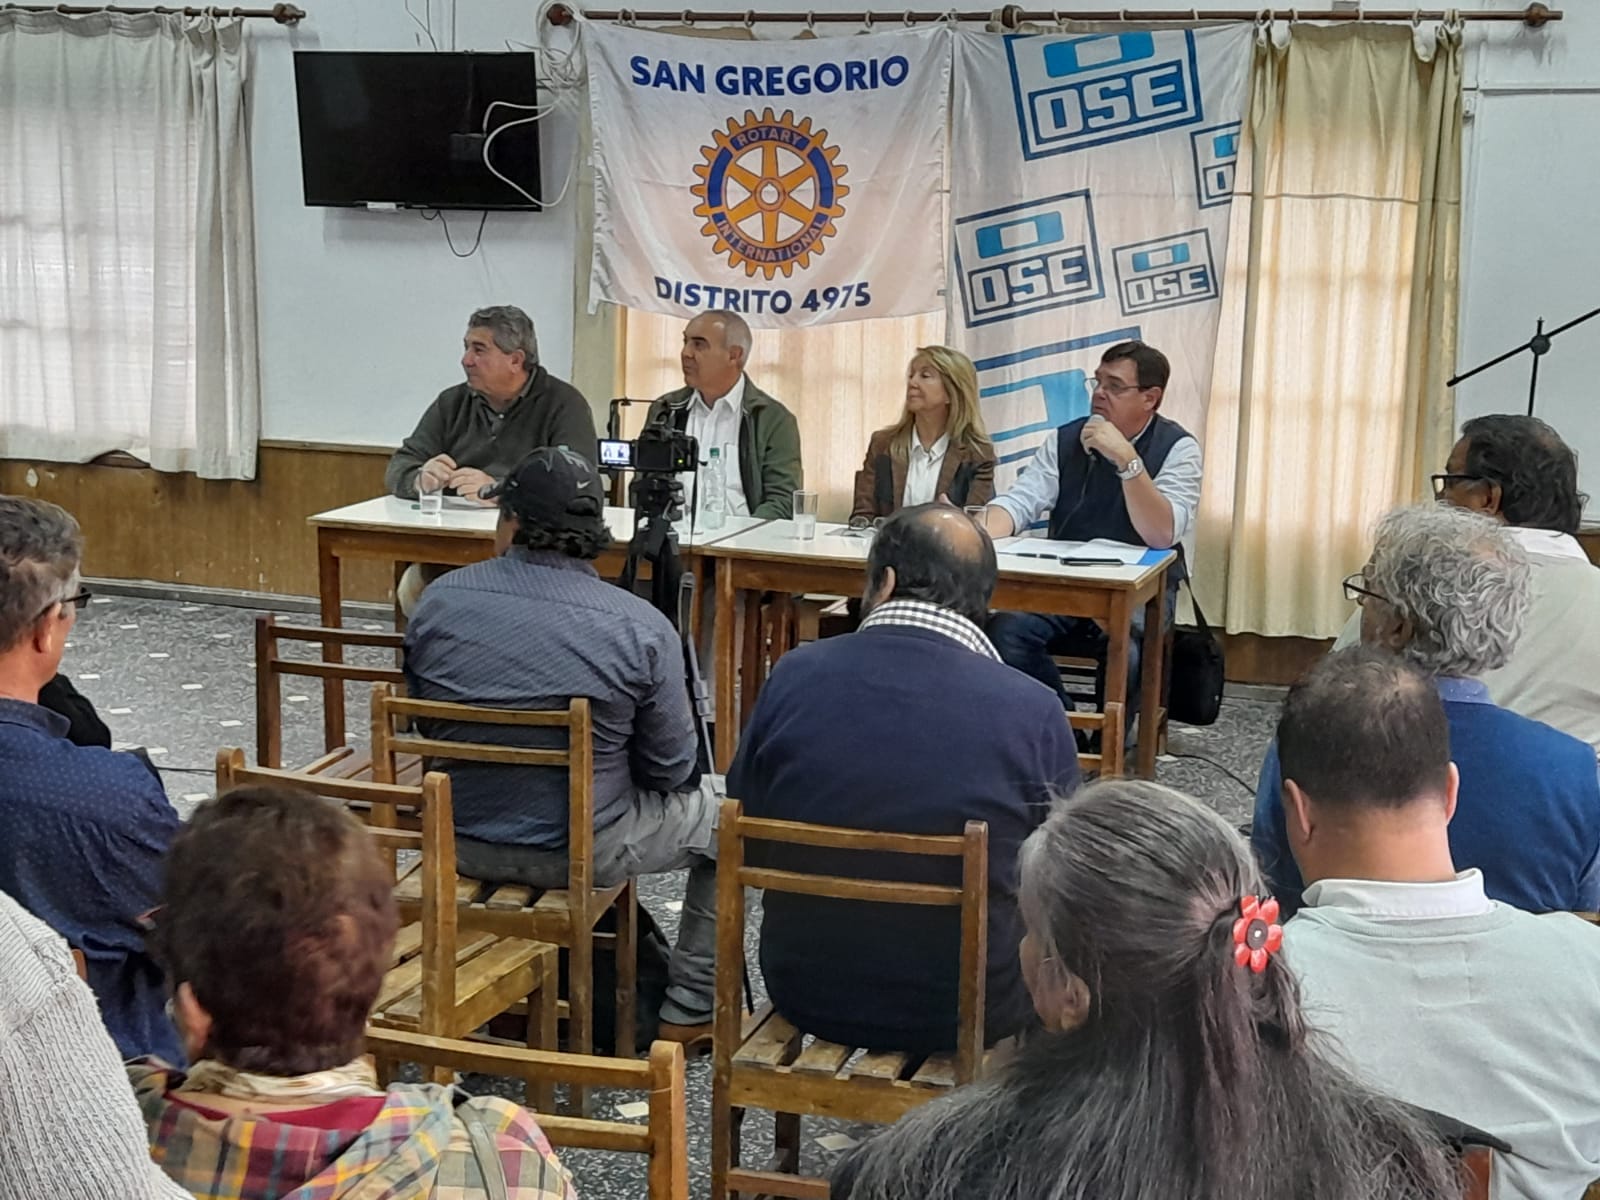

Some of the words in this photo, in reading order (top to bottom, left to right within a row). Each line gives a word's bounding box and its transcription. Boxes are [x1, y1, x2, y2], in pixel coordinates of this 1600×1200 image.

[630, 55, 706, 94] SAN
[715, 55, 910, 97] GREGORIO
[1033, 65, 1184, 140] OSE
[736, 127, 803, 149] ROTARY
[716, 214, 830, 262] INTERNATIONAL
[653, 275, 793, 315] DISTRITO
[800, 281, 872, 313] 4975
[969, 249, 1089, 313] OSE
[1127, 267, 1209, 307] OSE
